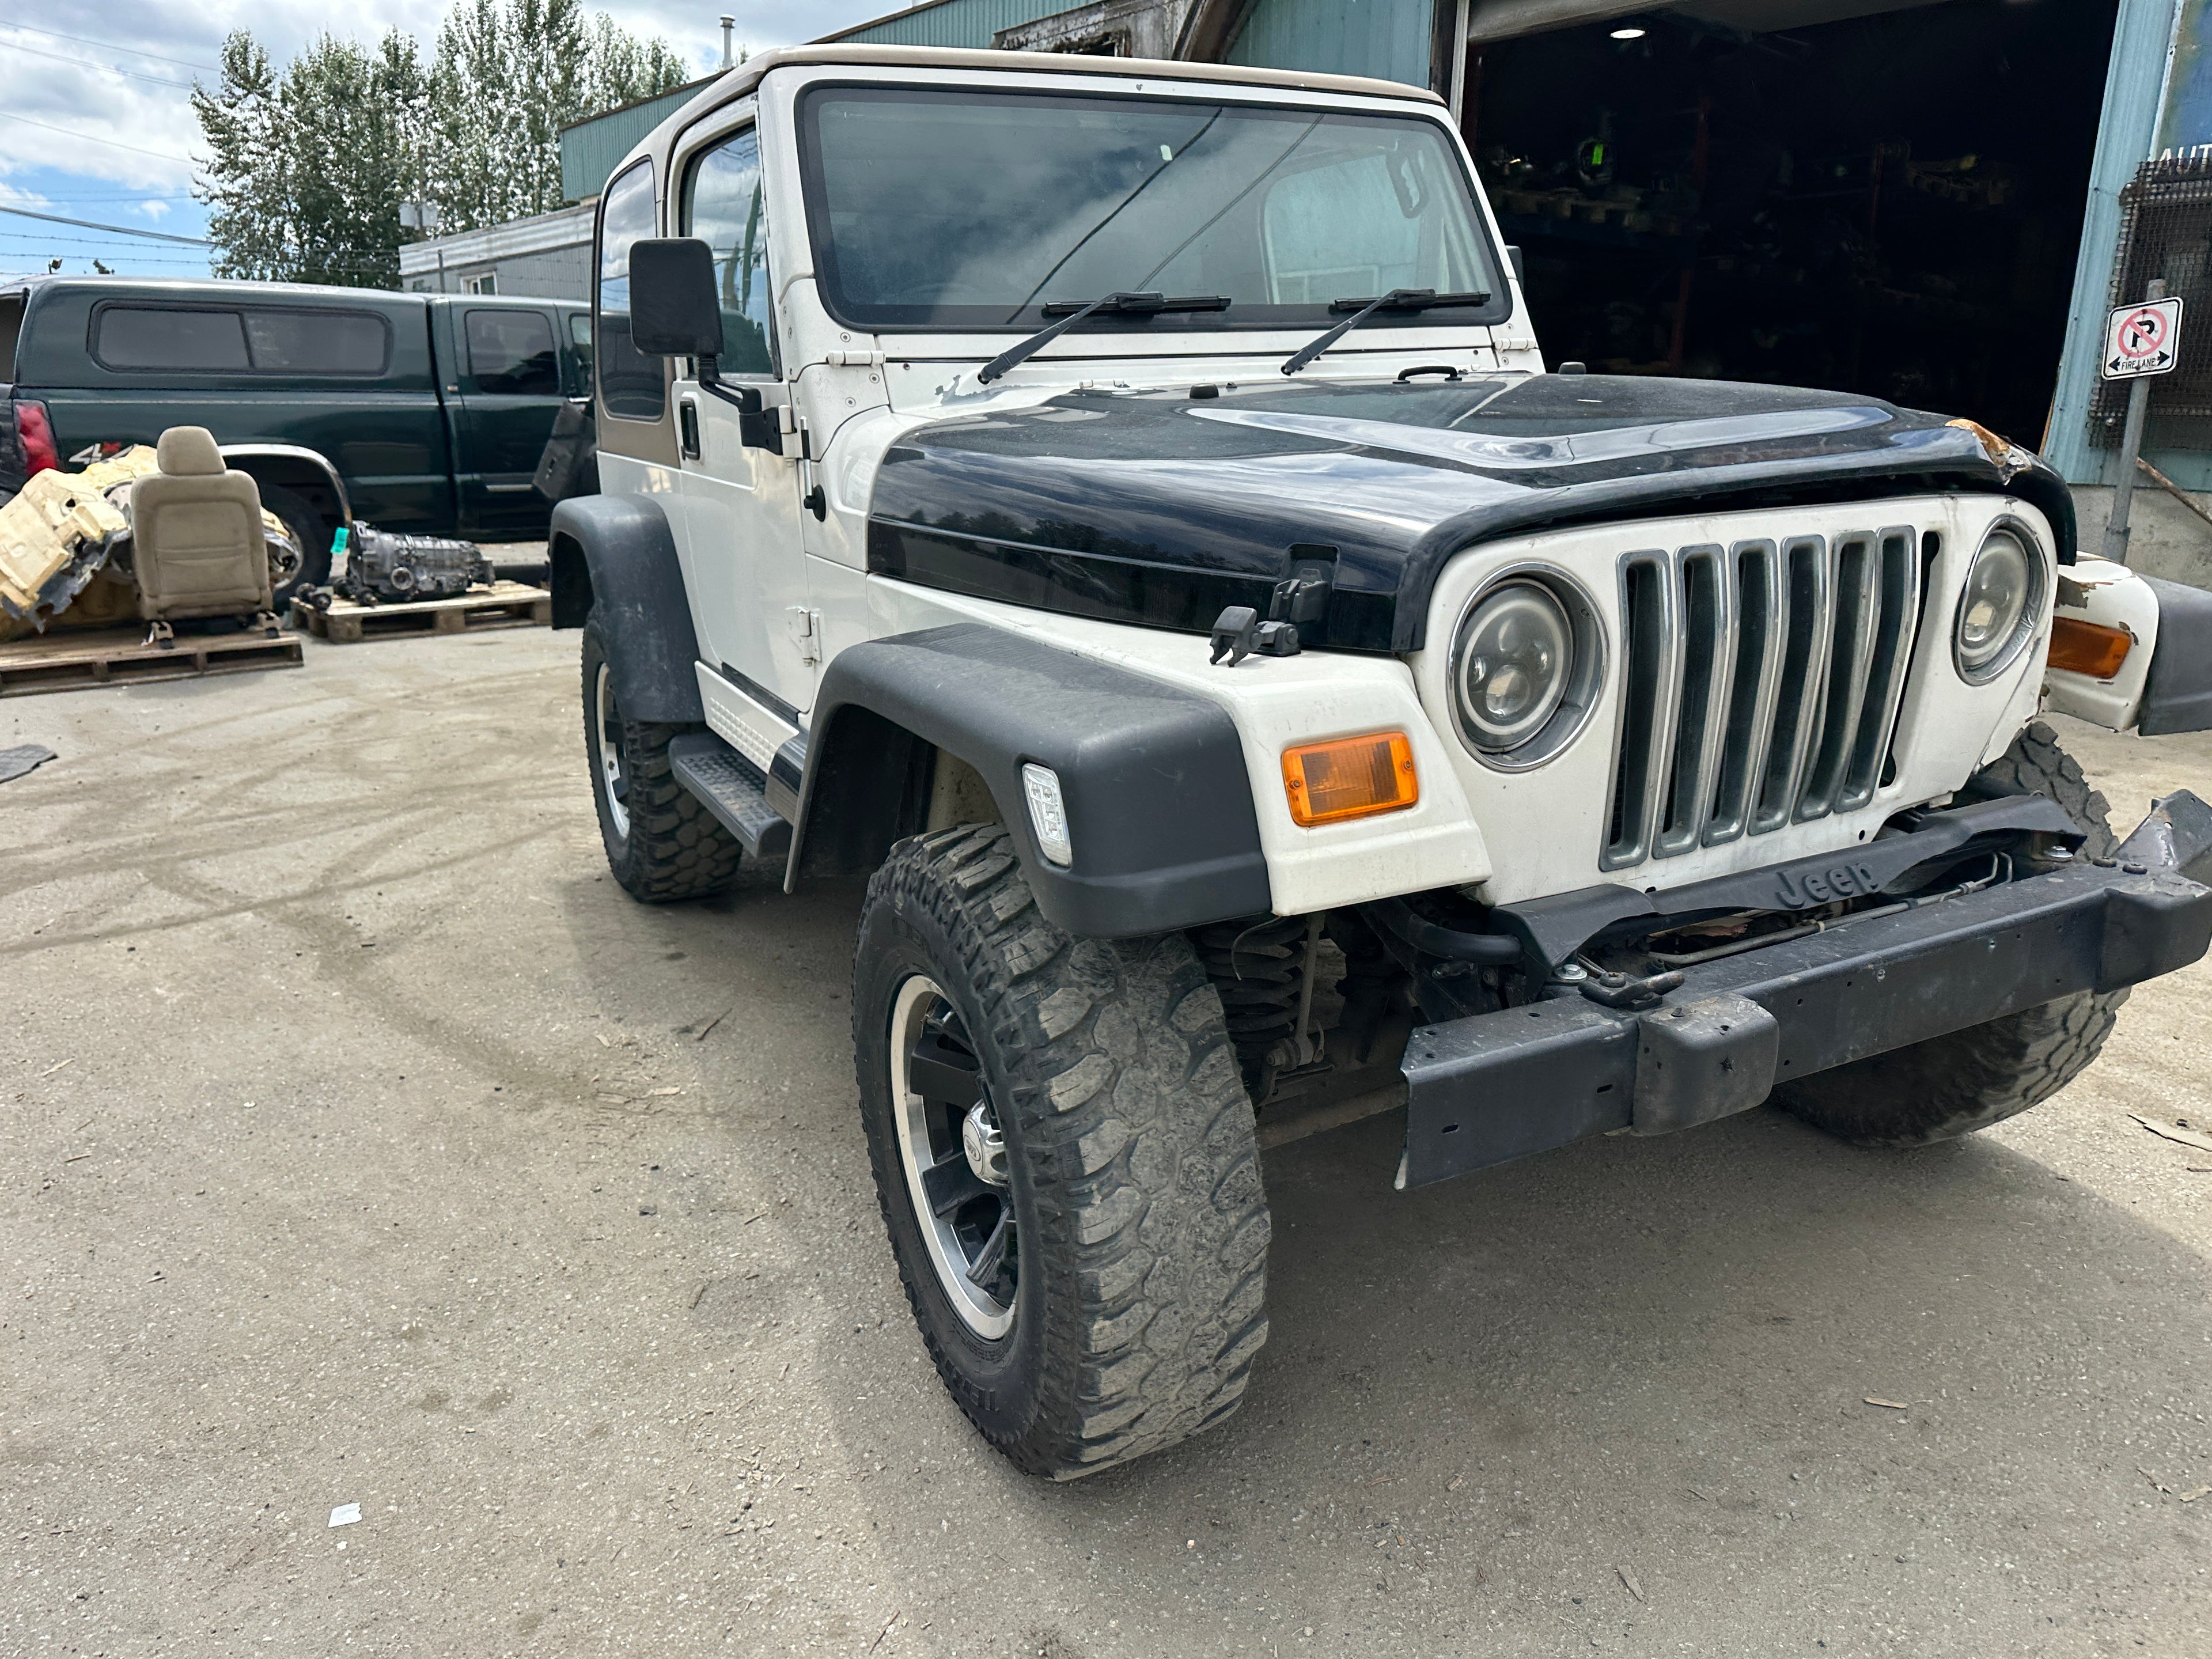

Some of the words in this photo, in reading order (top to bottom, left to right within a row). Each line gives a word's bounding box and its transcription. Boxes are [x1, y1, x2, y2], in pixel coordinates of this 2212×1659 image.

[2121, 359, 2137, 371] FIRE
[2138, 358, 2156, 369] LANE
[1775, 863, 1878, 909] Jeep
